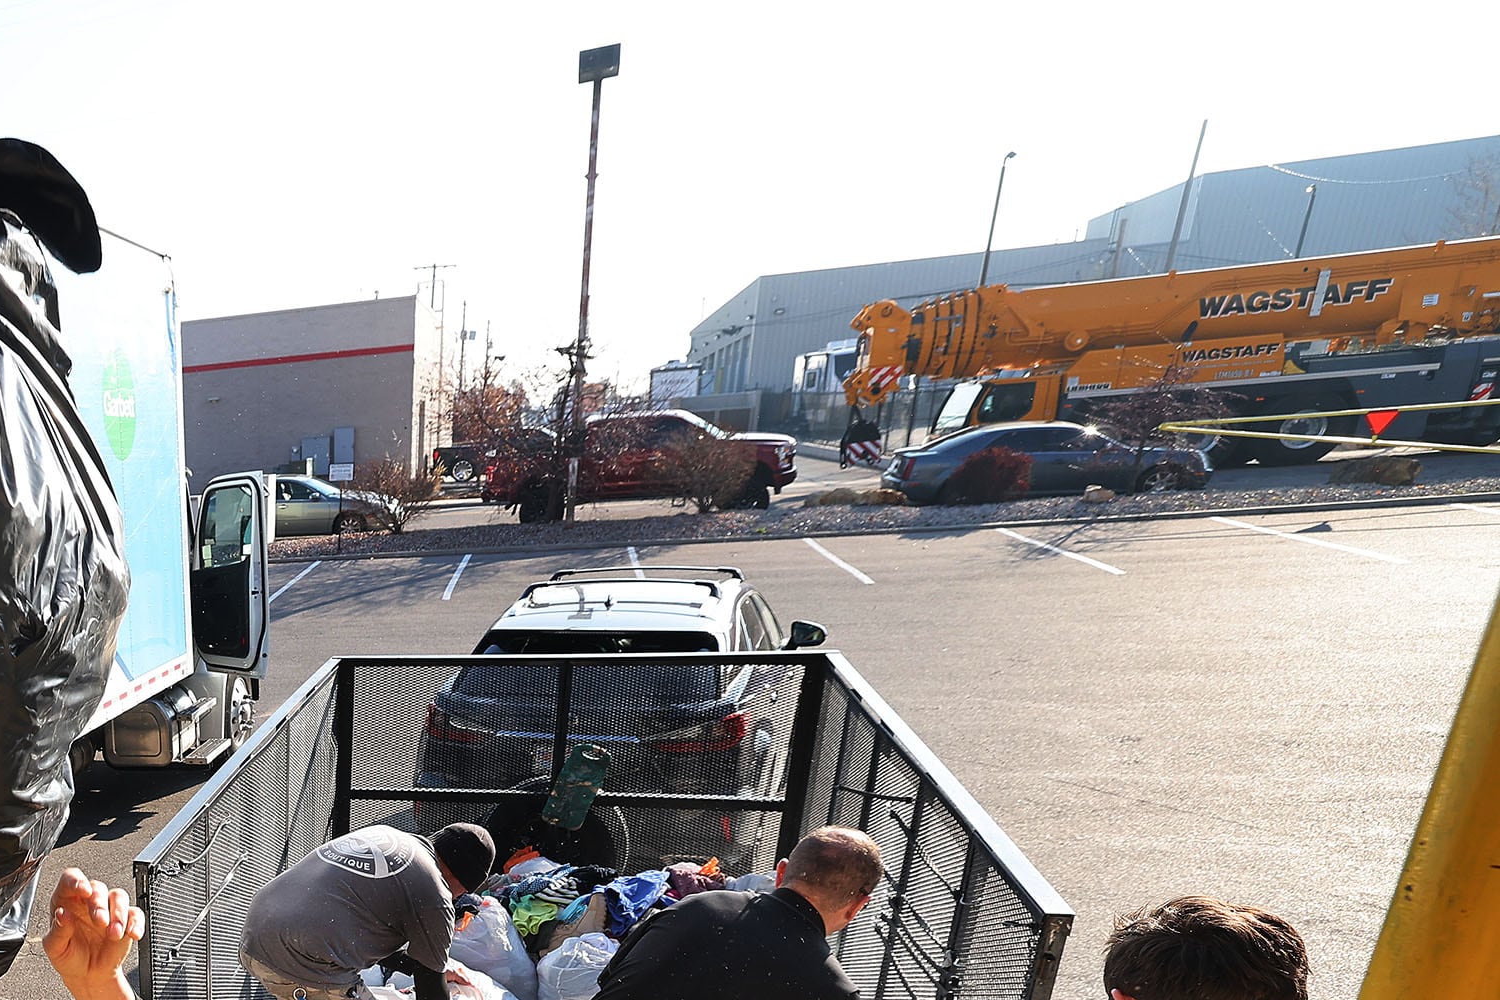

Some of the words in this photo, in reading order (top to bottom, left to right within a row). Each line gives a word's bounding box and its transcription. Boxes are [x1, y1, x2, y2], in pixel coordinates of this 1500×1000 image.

[1199, 277, 1395, 320] WAGSTAFF
[1182, 343, 1281, 364] WAGSTAFF
[323, 848, 371, 872] BOUTIQUE
